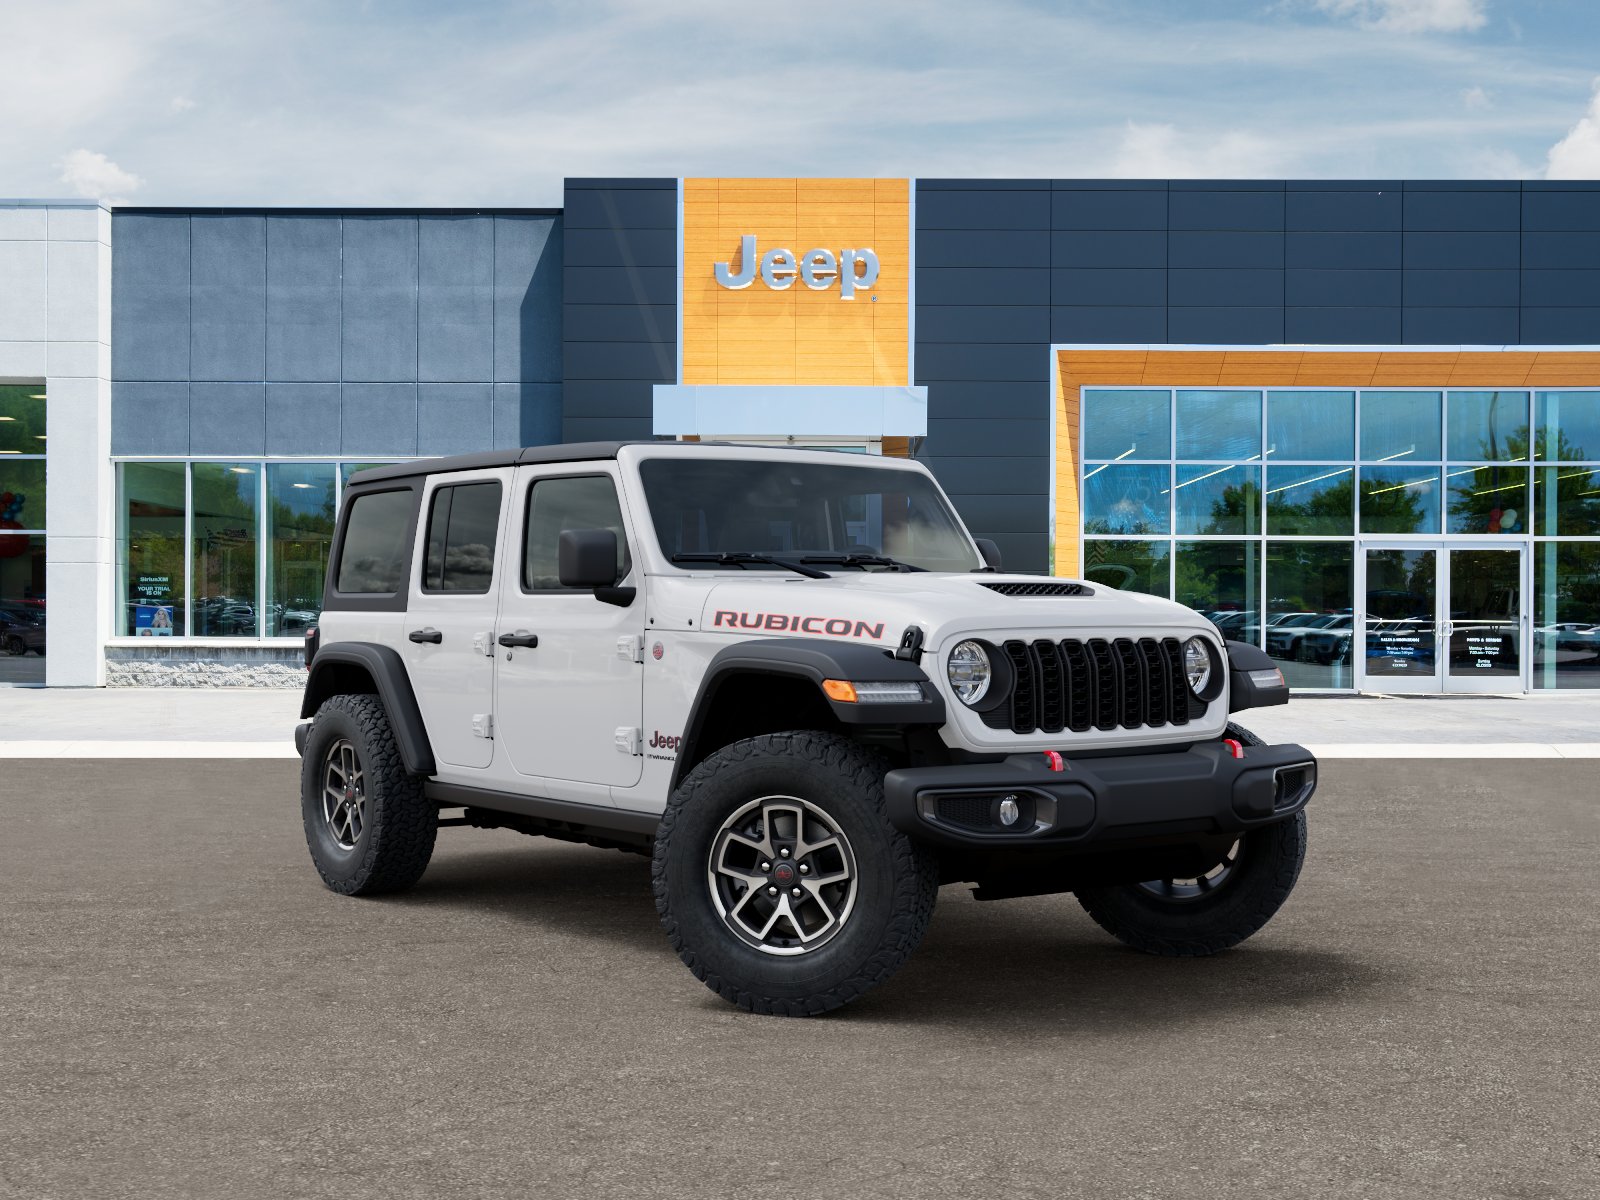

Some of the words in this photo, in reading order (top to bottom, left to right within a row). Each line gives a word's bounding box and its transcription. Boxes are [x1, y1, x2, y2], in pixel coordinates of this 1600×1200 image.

[714, 235, 880, 301] Jeep
[714, 611, 885, 641] RUBICON
[649, 730, 682, 754] Jeep
